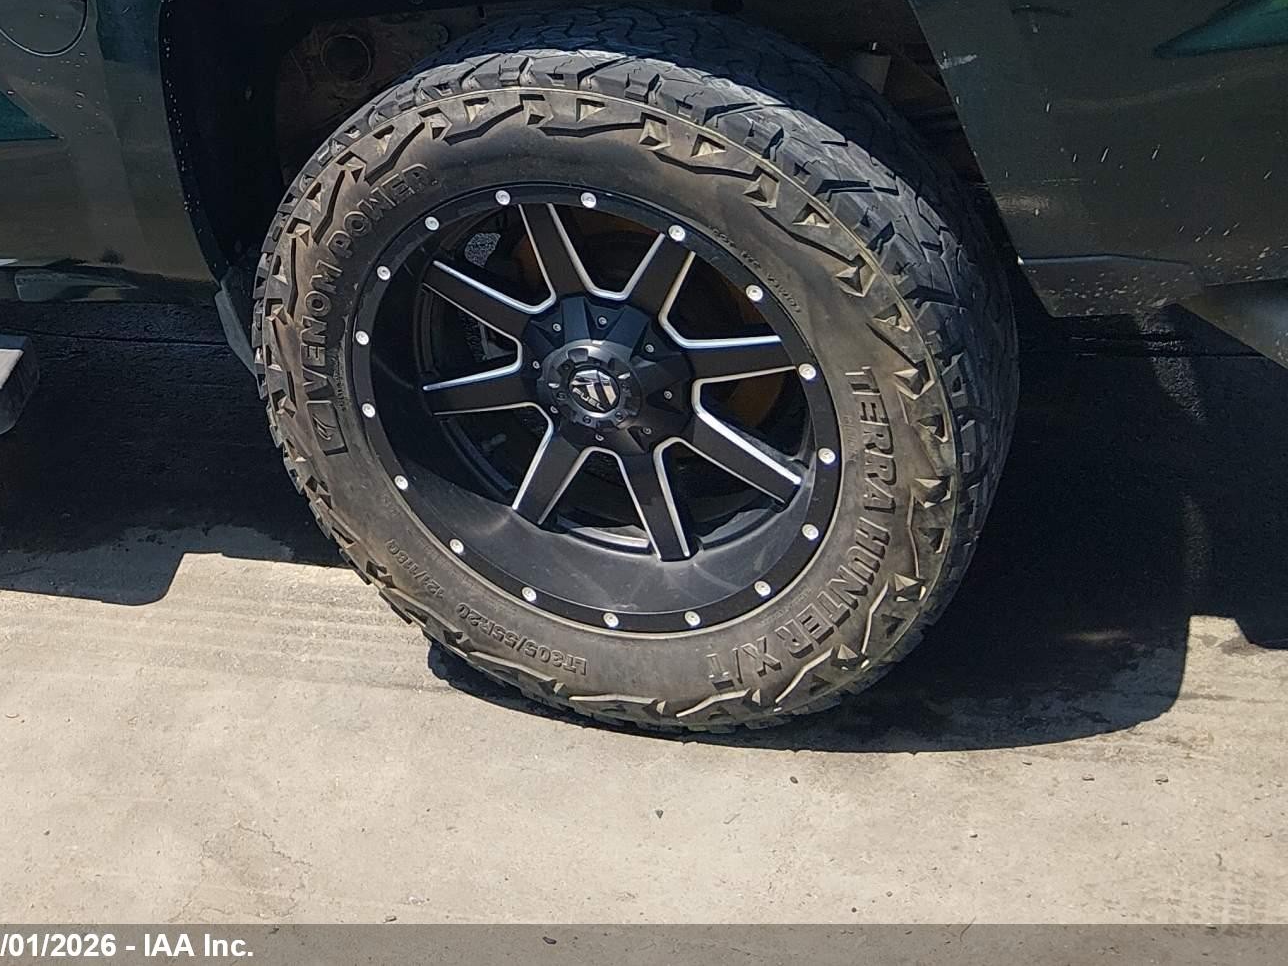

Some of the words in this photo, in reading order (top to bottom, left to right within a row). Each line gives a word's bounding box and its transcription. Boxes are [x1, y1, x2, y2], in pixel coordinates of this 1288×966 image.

[300, 258, 344, 400] VENOM
[326, 162, 432, 259] POWER
[572, 387, 605, 411] FUEL
[844, 366, 897, 515] TERRA
[456, 601, 588, 676] LT305/55R20
[774, 516, 890, 659] HUNTER
[706, 636, 783, 691] X/T
